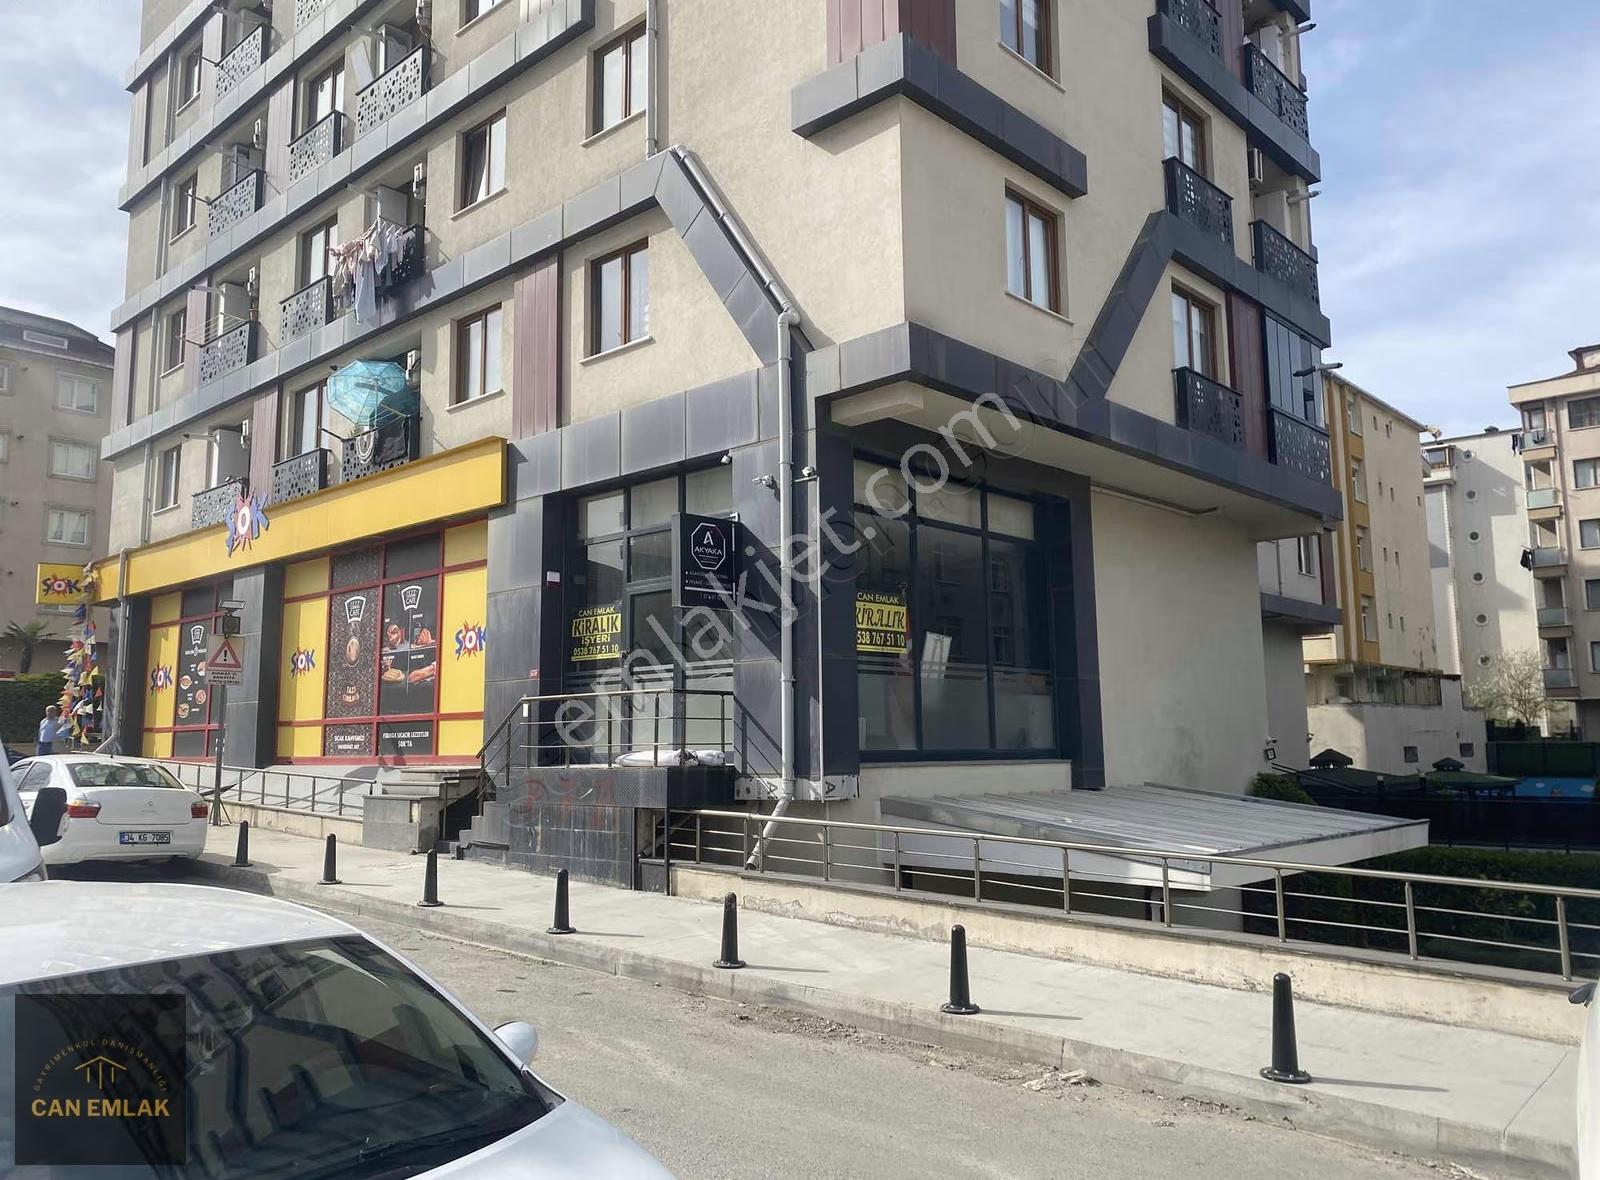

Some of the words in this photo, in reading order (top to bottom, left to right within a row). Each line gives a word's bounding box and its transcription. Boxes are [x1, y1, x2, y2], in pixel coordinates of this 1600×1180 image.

[694, 546, 723, 556] AKYAKA
[857, 592, 874, 601] CAN
[876, 594, 899, 604] EMLAK
[578, 608, 593, 618] CAN
[593, 605, 616, 615] EMLAK
[573, 615, 619, 636] KİRALIK
[581, 634, 611, 647] İŞYERİ
[872, 632, 884, 645] 767
[886, 633, 894, 645] 51
[897, 634, 905, 646] 10
[573, 646, 588, 656] 0538
[589, 645, 600, 654] 767
[601, 645, 609, 653] 51
[611, 643, 619, 652] 10
[125, 833, 135, 842] 34
